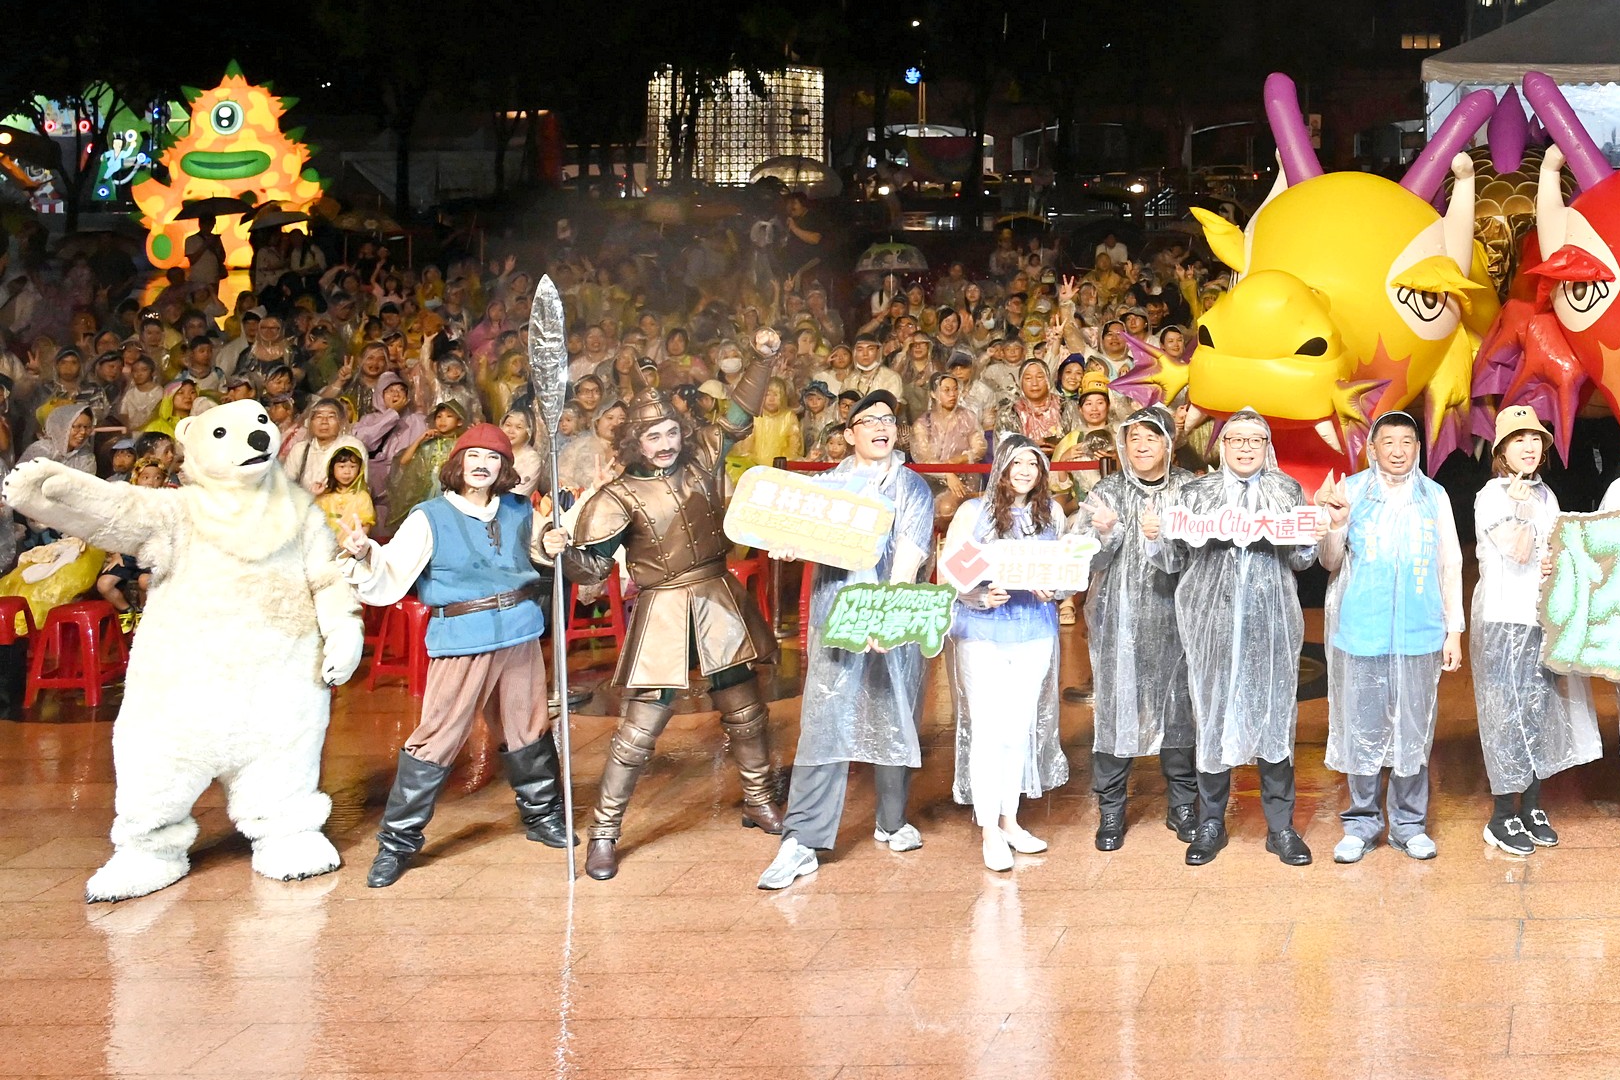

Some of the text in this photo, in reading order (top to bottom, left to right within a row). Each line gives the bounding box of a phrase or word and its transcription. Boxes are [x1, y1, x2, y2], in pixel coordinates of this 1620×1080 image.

[1168, 508, 1252, 543] Mega City
[1254, 512, 1318, 540] 大遠百
[997, 561, 1084, 586] 裕隆城
